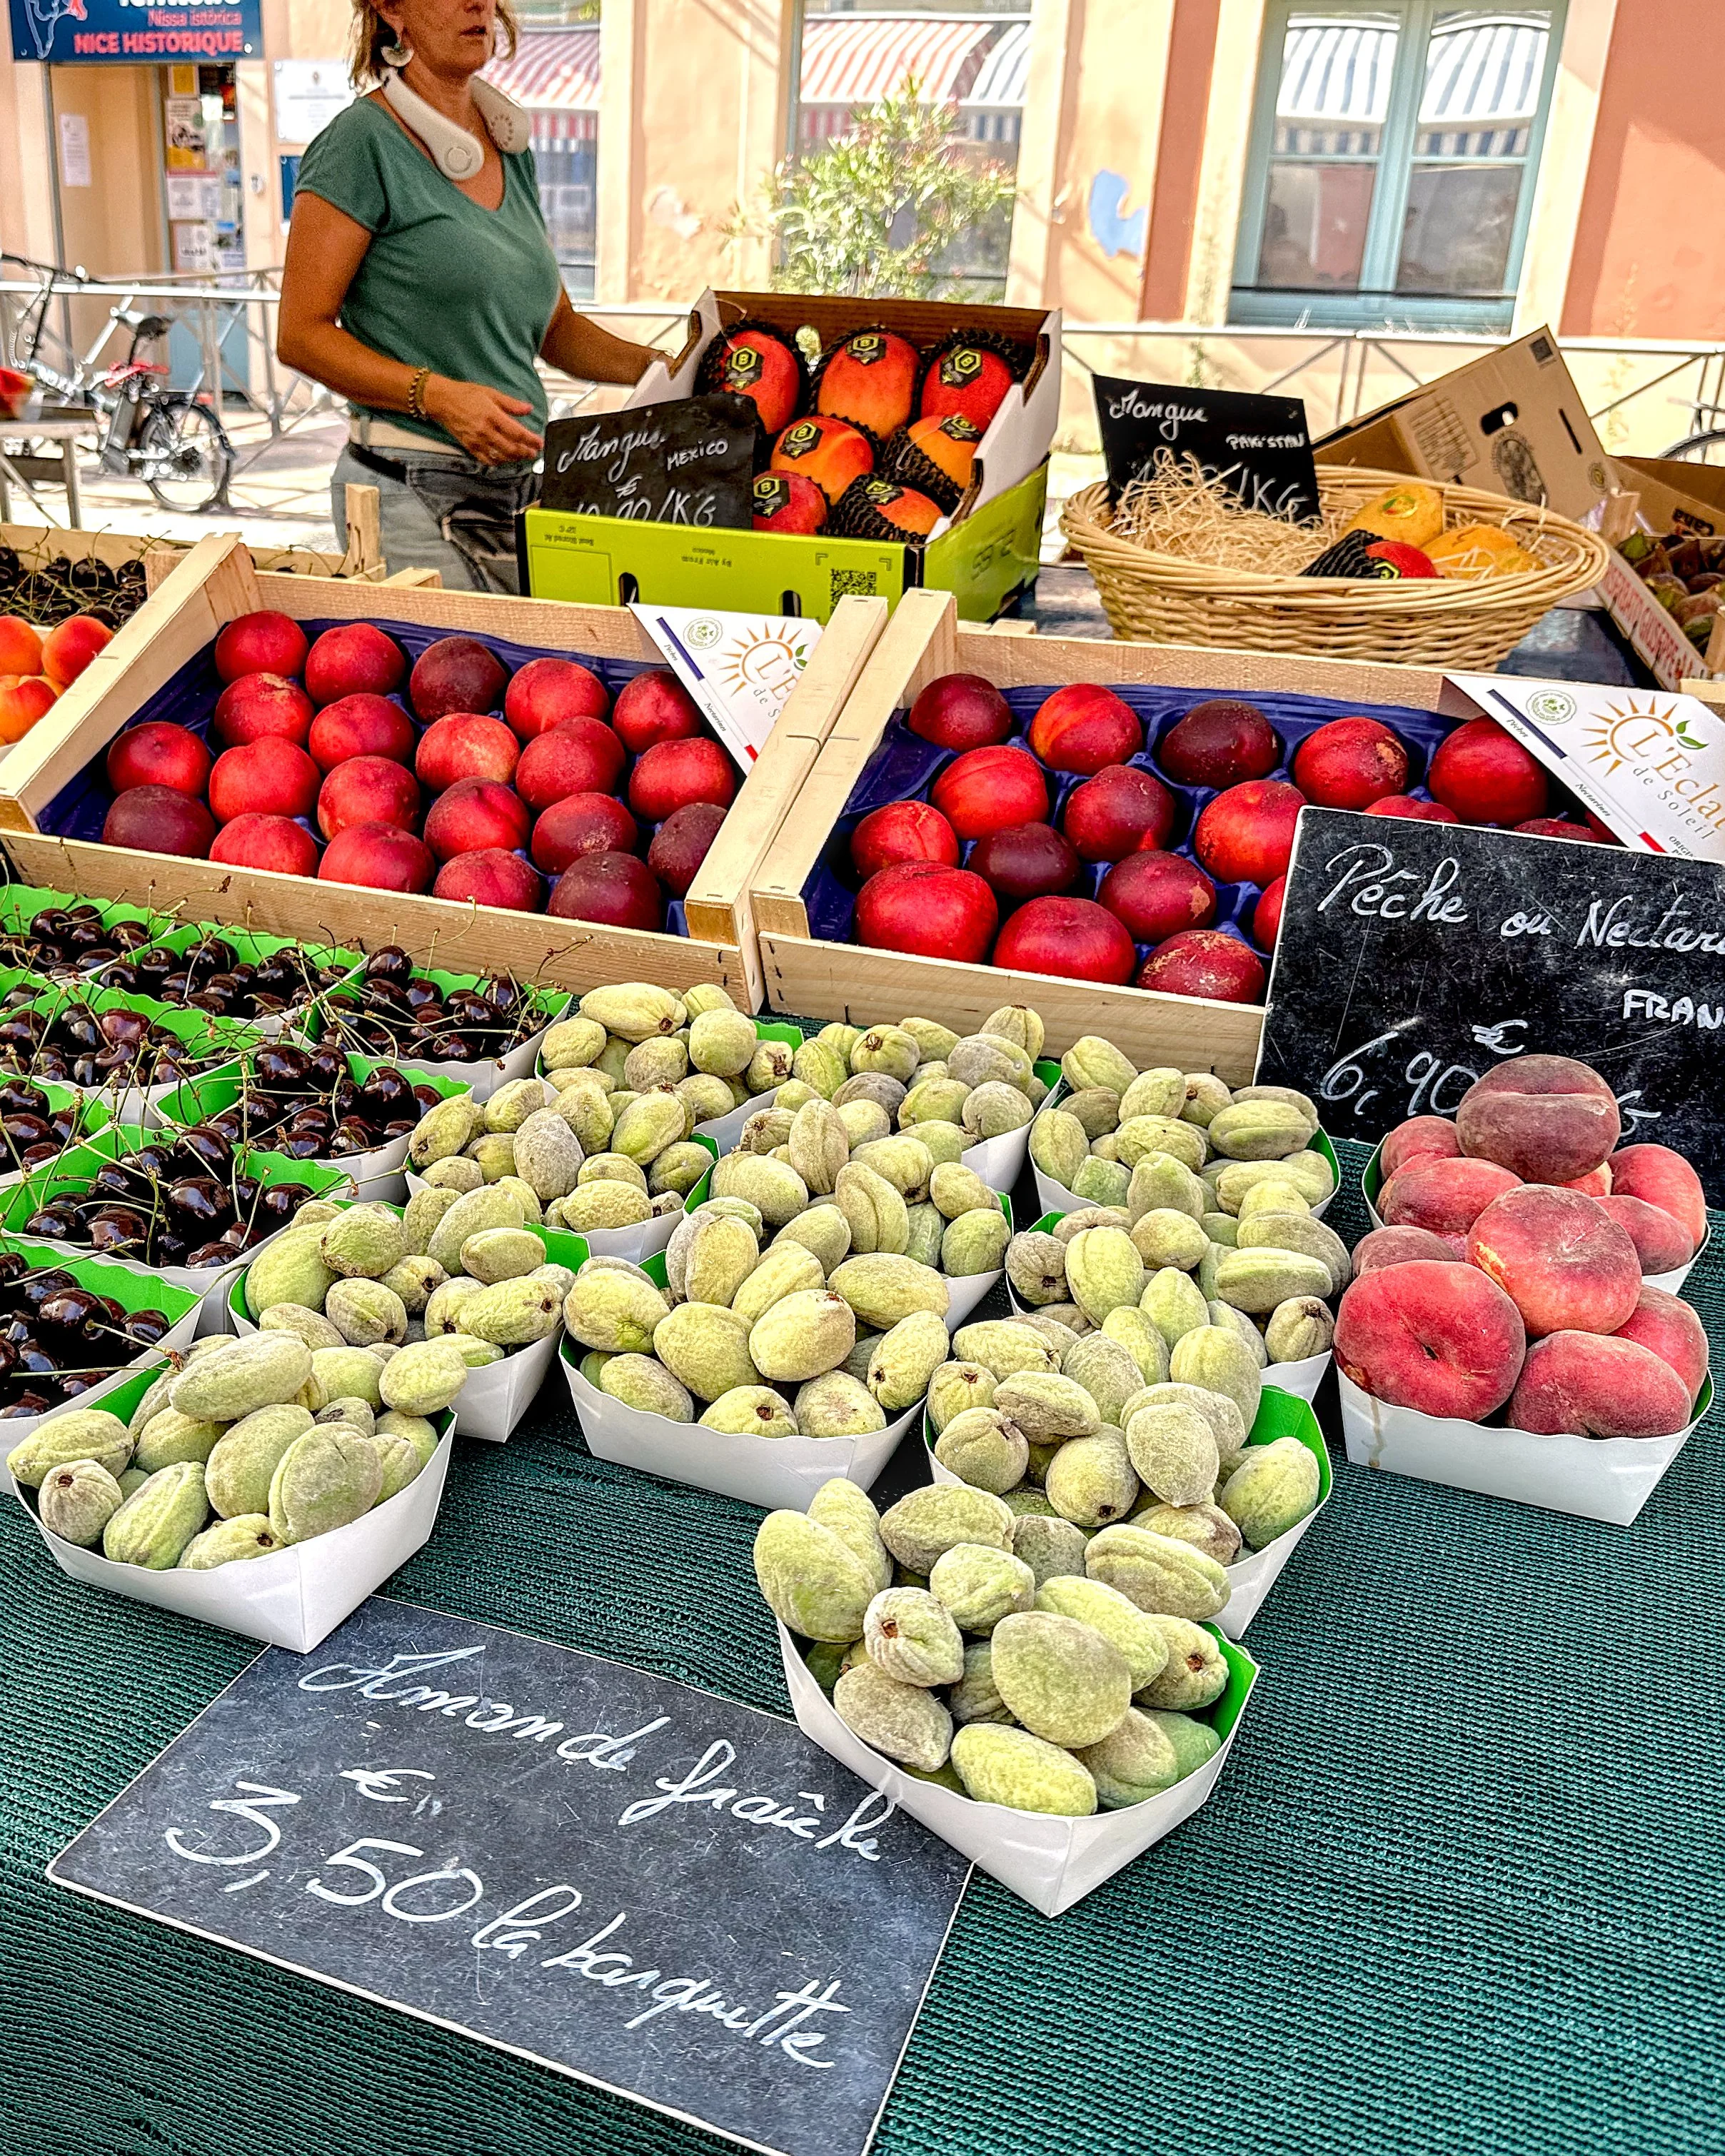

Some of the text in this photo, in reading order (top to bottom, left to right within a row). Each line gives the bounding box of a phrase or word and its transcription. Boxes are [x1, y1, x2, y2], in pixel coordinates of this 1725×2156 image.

[148, 9, 187, 26] Nissa
[74, 31, 243, 56] NICE HISTORIQUE
[753, 688, 768, 705] de
[704, 702, 727, 732] Nectarines
[1575, 783, 1611, 817] Nectarines
[1632, 767, 1716, 840] de Soleil
[1317, 843, 1469, 924] Pêche
[1501, 911, 1551, 937] ou
[1622, 989, 1725, 1029] FRAN
[1472, 1019, 1529, 1054] €
[165, 1780, 853, 2069] 3,50 la barquette
